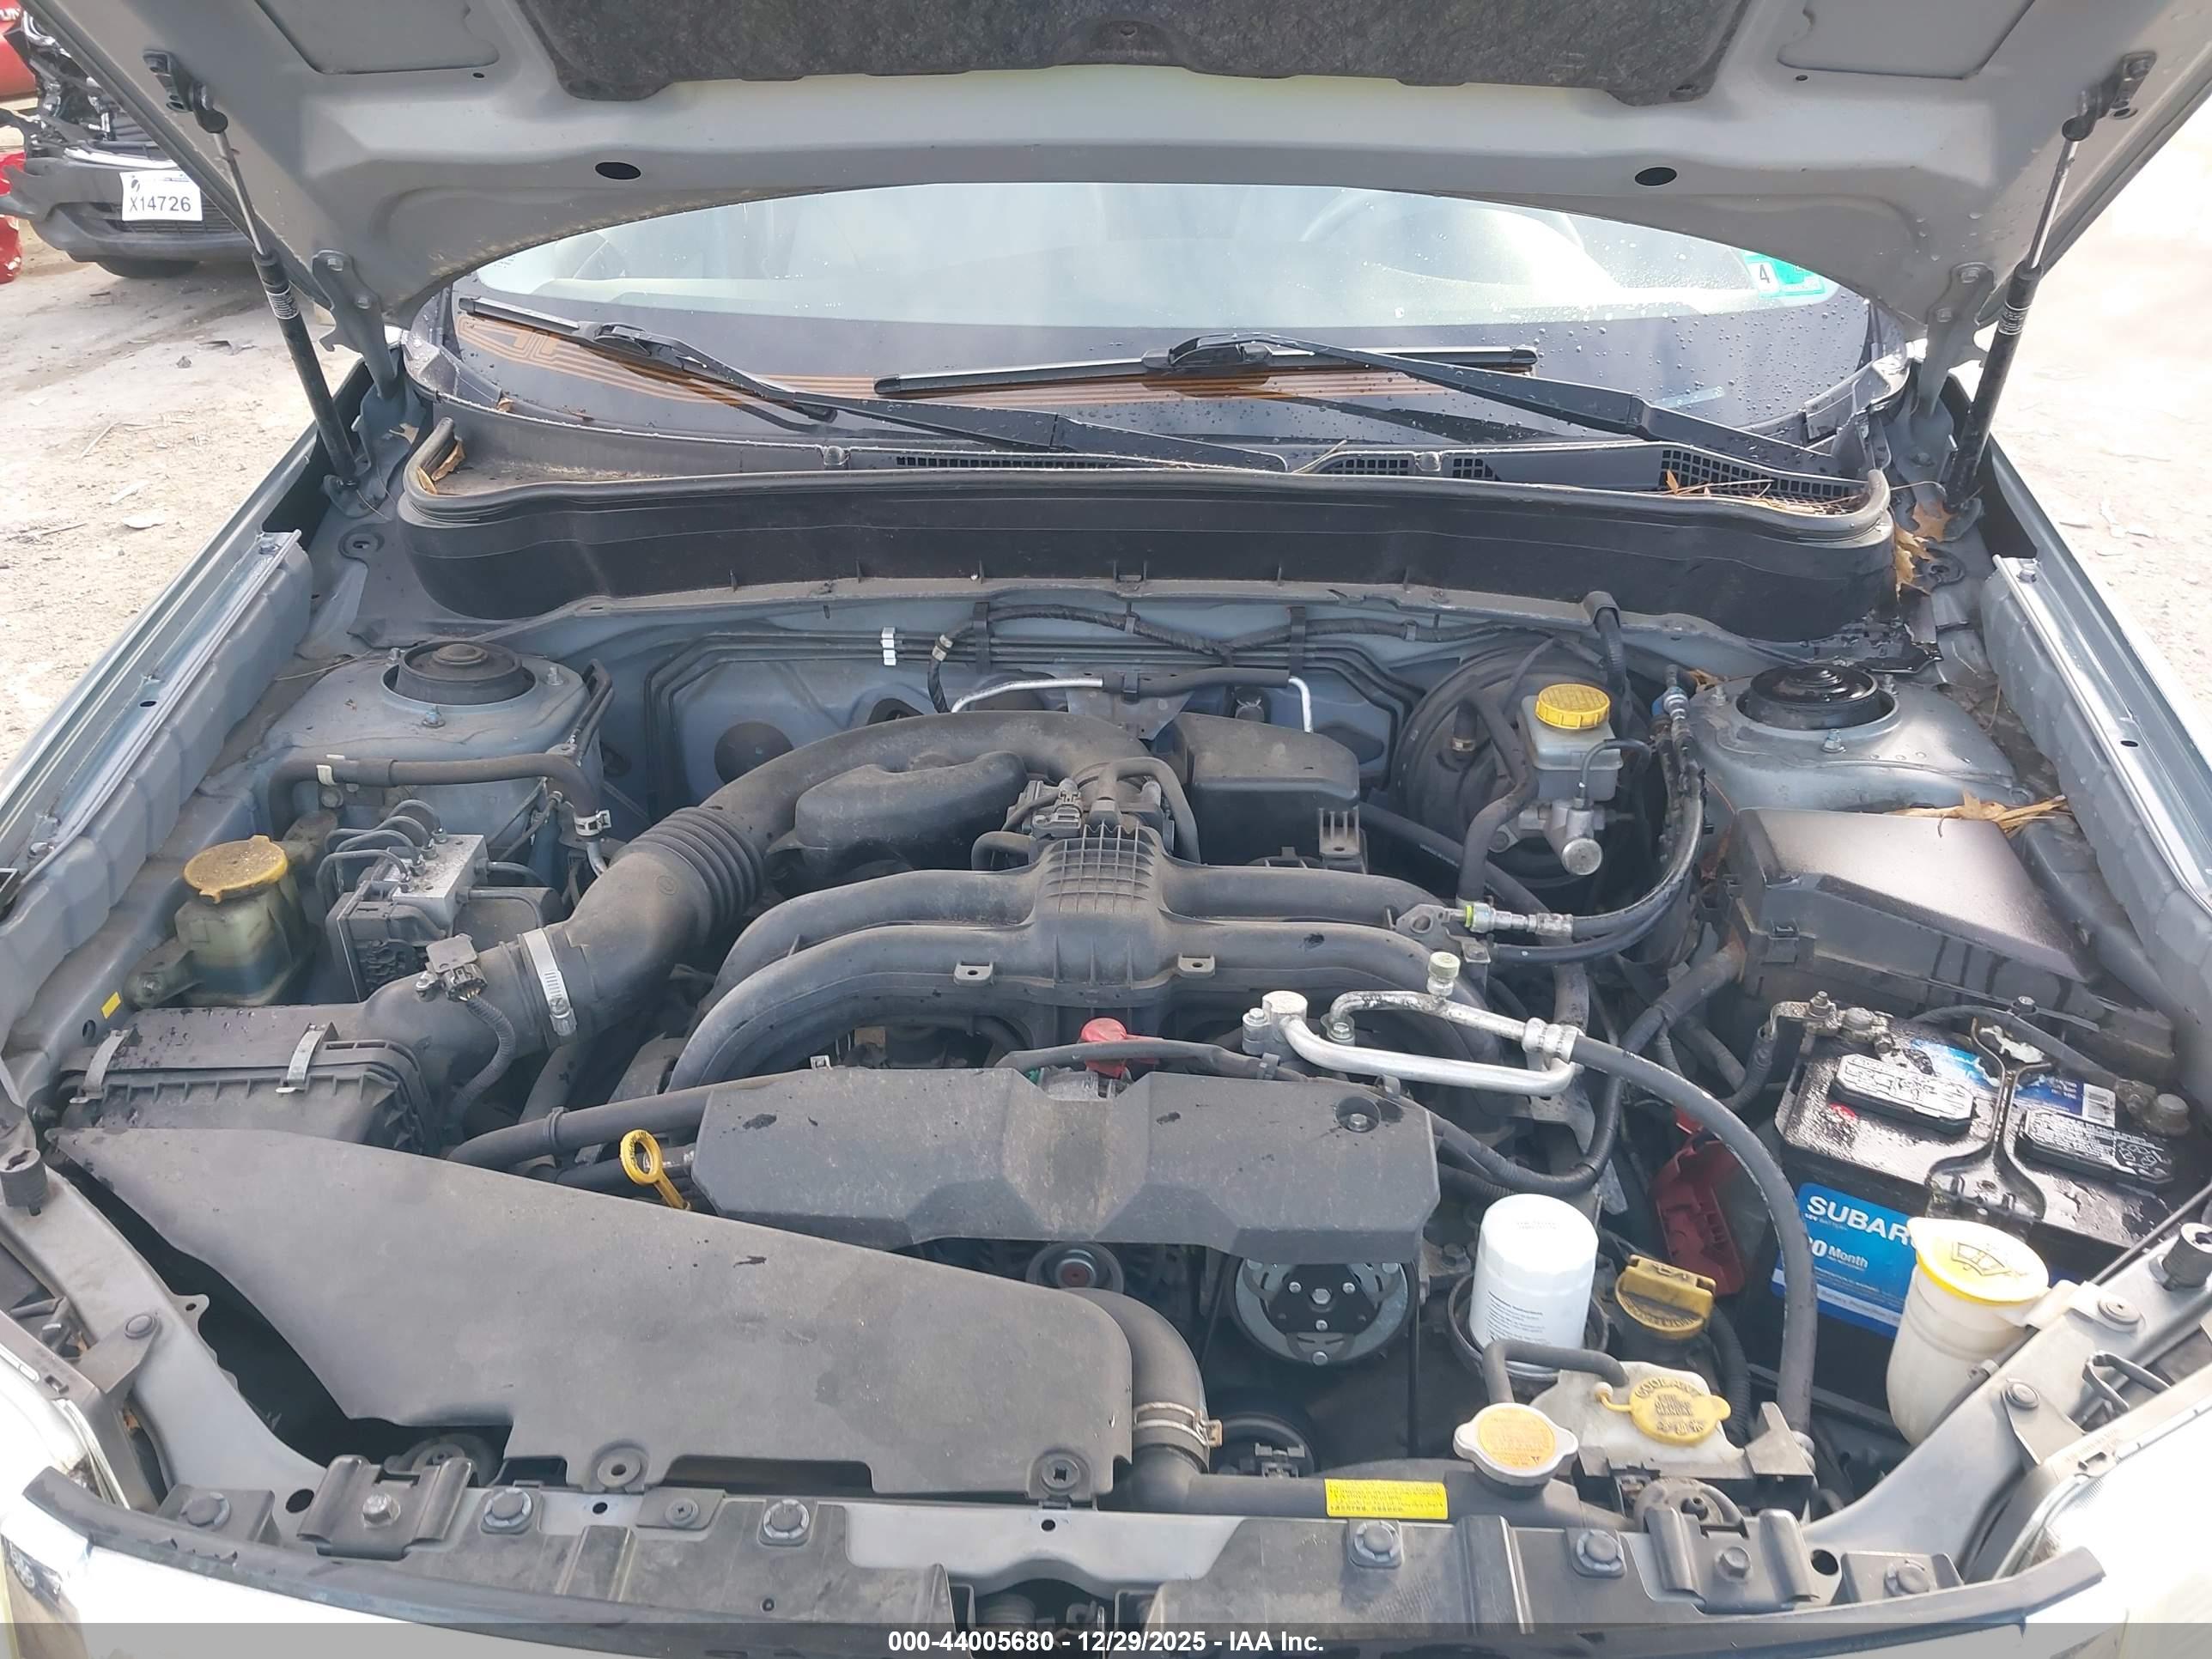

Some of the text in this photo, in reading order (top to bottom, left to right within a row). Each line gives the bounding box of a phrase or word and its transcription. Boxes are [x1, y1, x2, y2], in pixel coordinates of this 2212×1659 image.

[130, 196, 191, 212] X14726
[1759, 264, 1771, 283] 4
[1807, 1195, 1917, 1250] SUBAR
[1808, 1236, 1827, 1257] 0
[1828, 1245, 1869, 1268] Month
